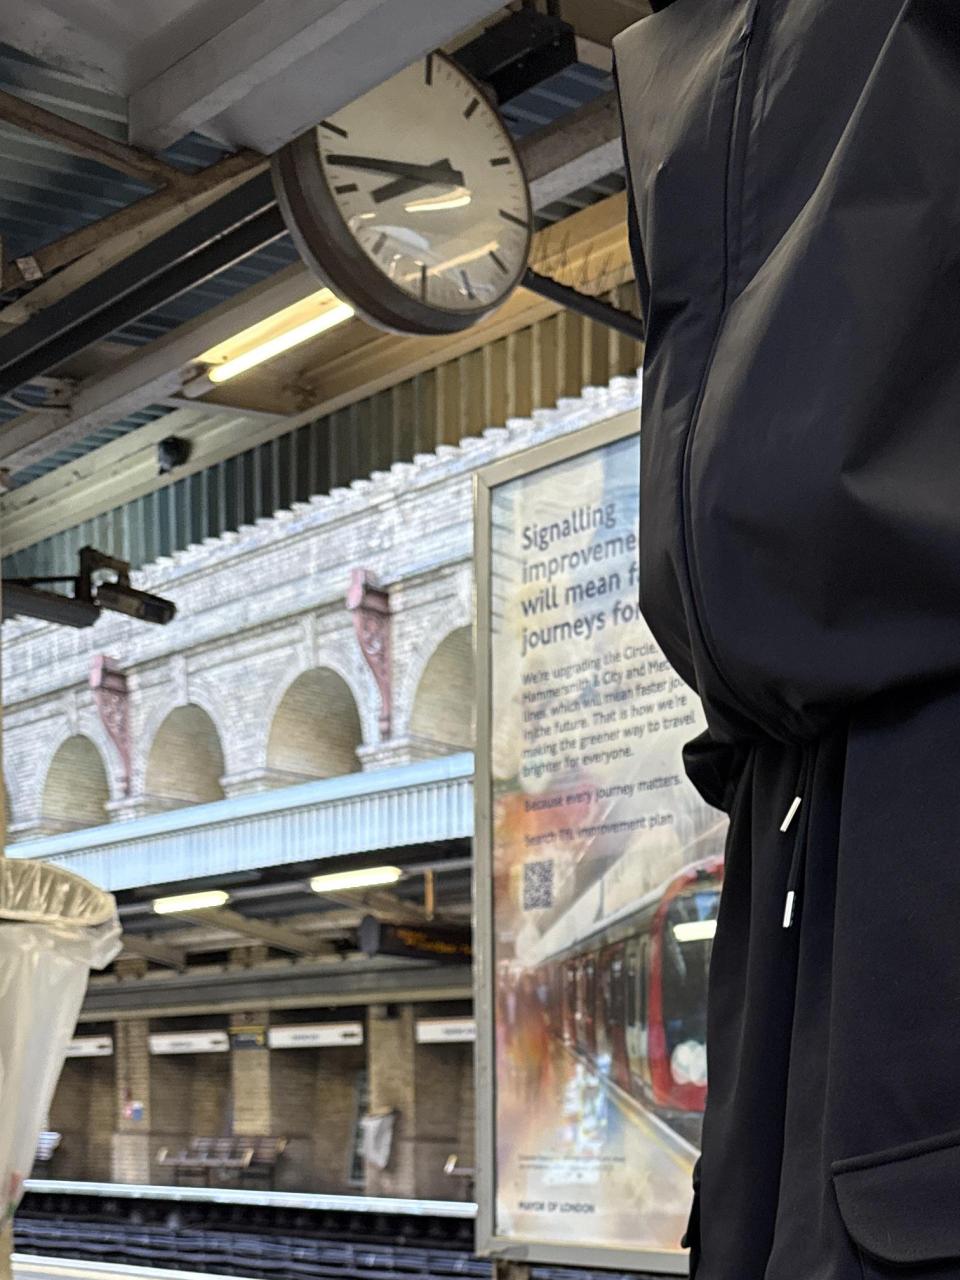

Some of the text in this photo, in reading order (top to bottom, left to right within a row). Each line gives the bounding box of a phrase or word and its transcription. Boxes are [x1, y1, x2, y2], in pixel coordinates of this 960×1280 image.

[522, 503, 617, 551] Signalling
[522, 531, 637, 584] improveme
[521, 561, 640, 617] will mean f
[521, 611, 606, 657] journeys
[523, 670, 550, 686] We're
[552, 658, 600, 680] upgrading
[602, 650, 621, 666] the
[523, 679, 590, 703] Hammersmith
[601, 670, 622, 688] City
[625, 664, 646, 680] and
[648, 660, 671, 674] Met
[550, 700, 581, 715] which
[634, 680, 667, 697] faster
[668, 677, 685, 693] jou
[593, 710, 617, 724] That
[619, 708, 628, 720] is
[630, 704, 655, 718] how
[657, 694, 688, 711] we're
[522, 711, 696, 758] making the greener way to travel
[564, 754, 580, 769] for
[581, 746, 634, 764] everyone.
[595, 783, 636, 802] journey
[637, 775, 683, 791] matters.
[577, 819, 646, 838] improvement
[649, 812, 674, 829] plan
[518, 1200, 595, 1214] MAYOR OF LONDON
